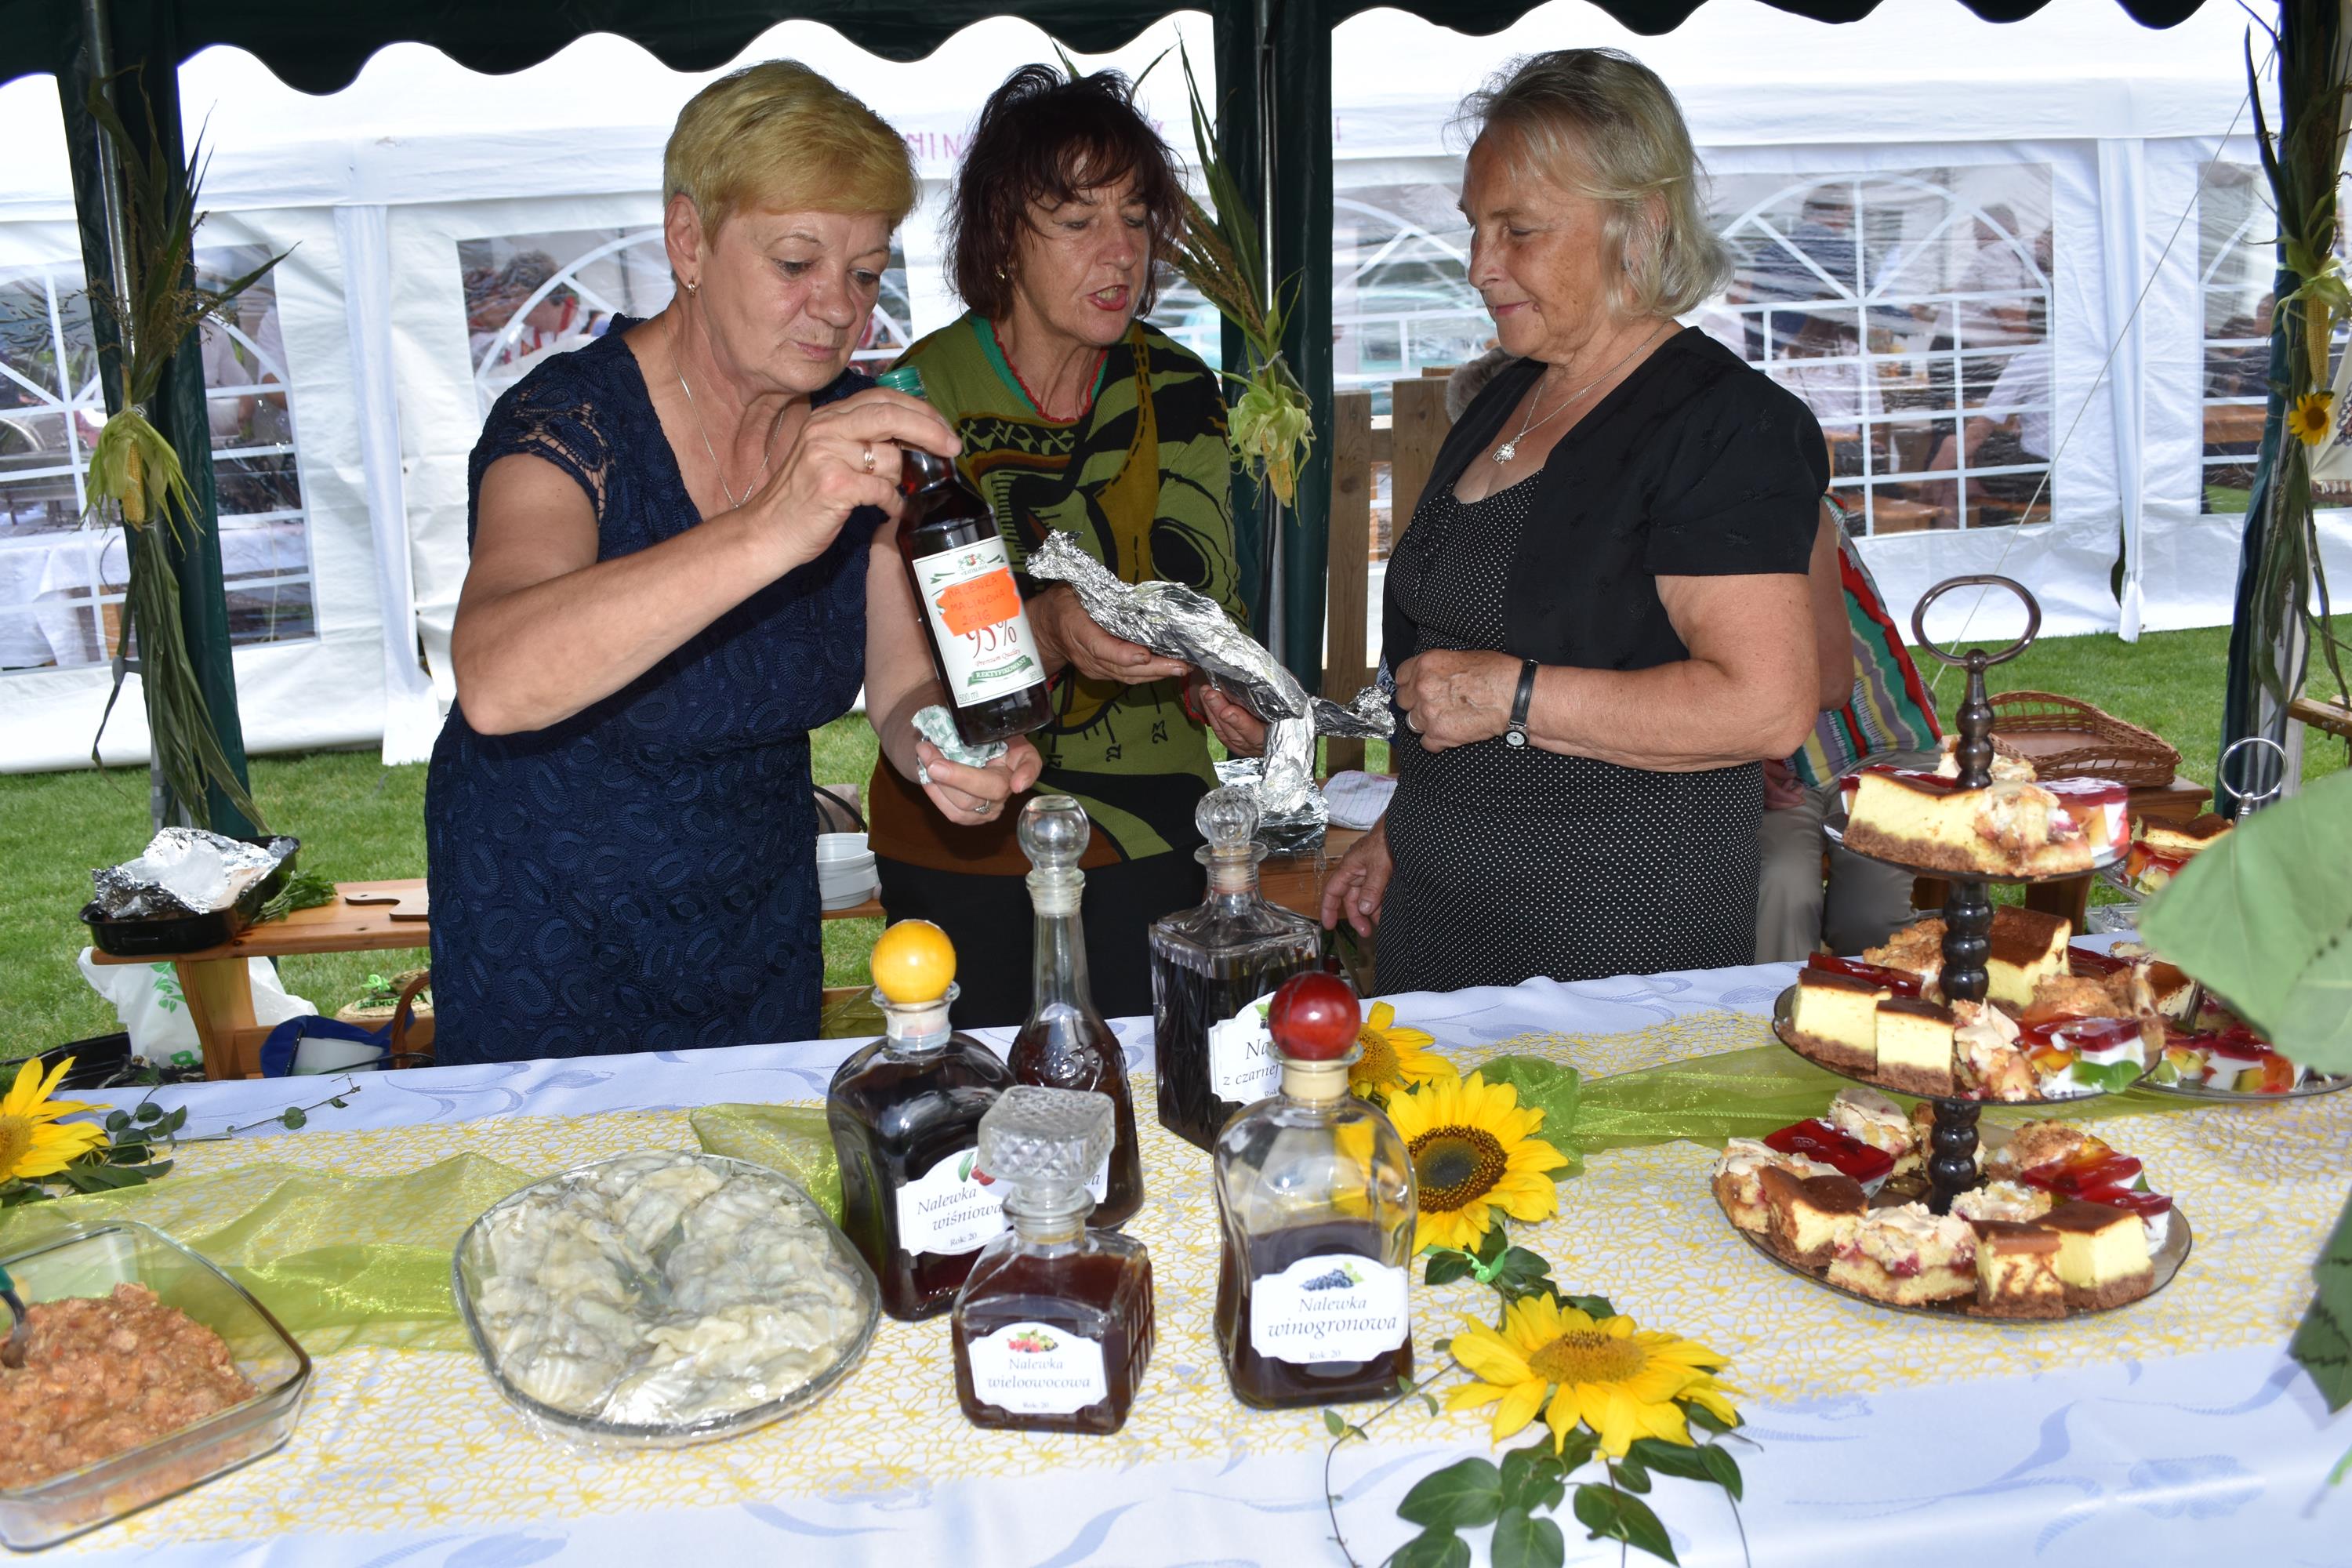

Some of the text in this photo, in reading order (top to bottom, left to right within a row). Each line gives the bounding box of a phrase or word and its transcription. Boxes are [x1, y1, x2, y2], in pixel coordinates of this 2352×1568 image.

[962, 609, 992, 626] 2016
[1151, 720, 1168, 744] 23
[1105, 744, 1121, 762] 22
[1223, 1064, 1279, 1086] z czarnej
[917, 1186, 978, 1215] Nalewka
[932, 1203, 1004, 1232] wiśniowa
[949, 1236, 966, 1247] Rok:
[1298, 1296, 1367, 1313] Nalewka
[1267, 1316, 1398, 1341] winogronowa
[1008, 1357, 1064, 1370] Nalewka
[986, 1374, 1091, 1388] wieloowocowa
